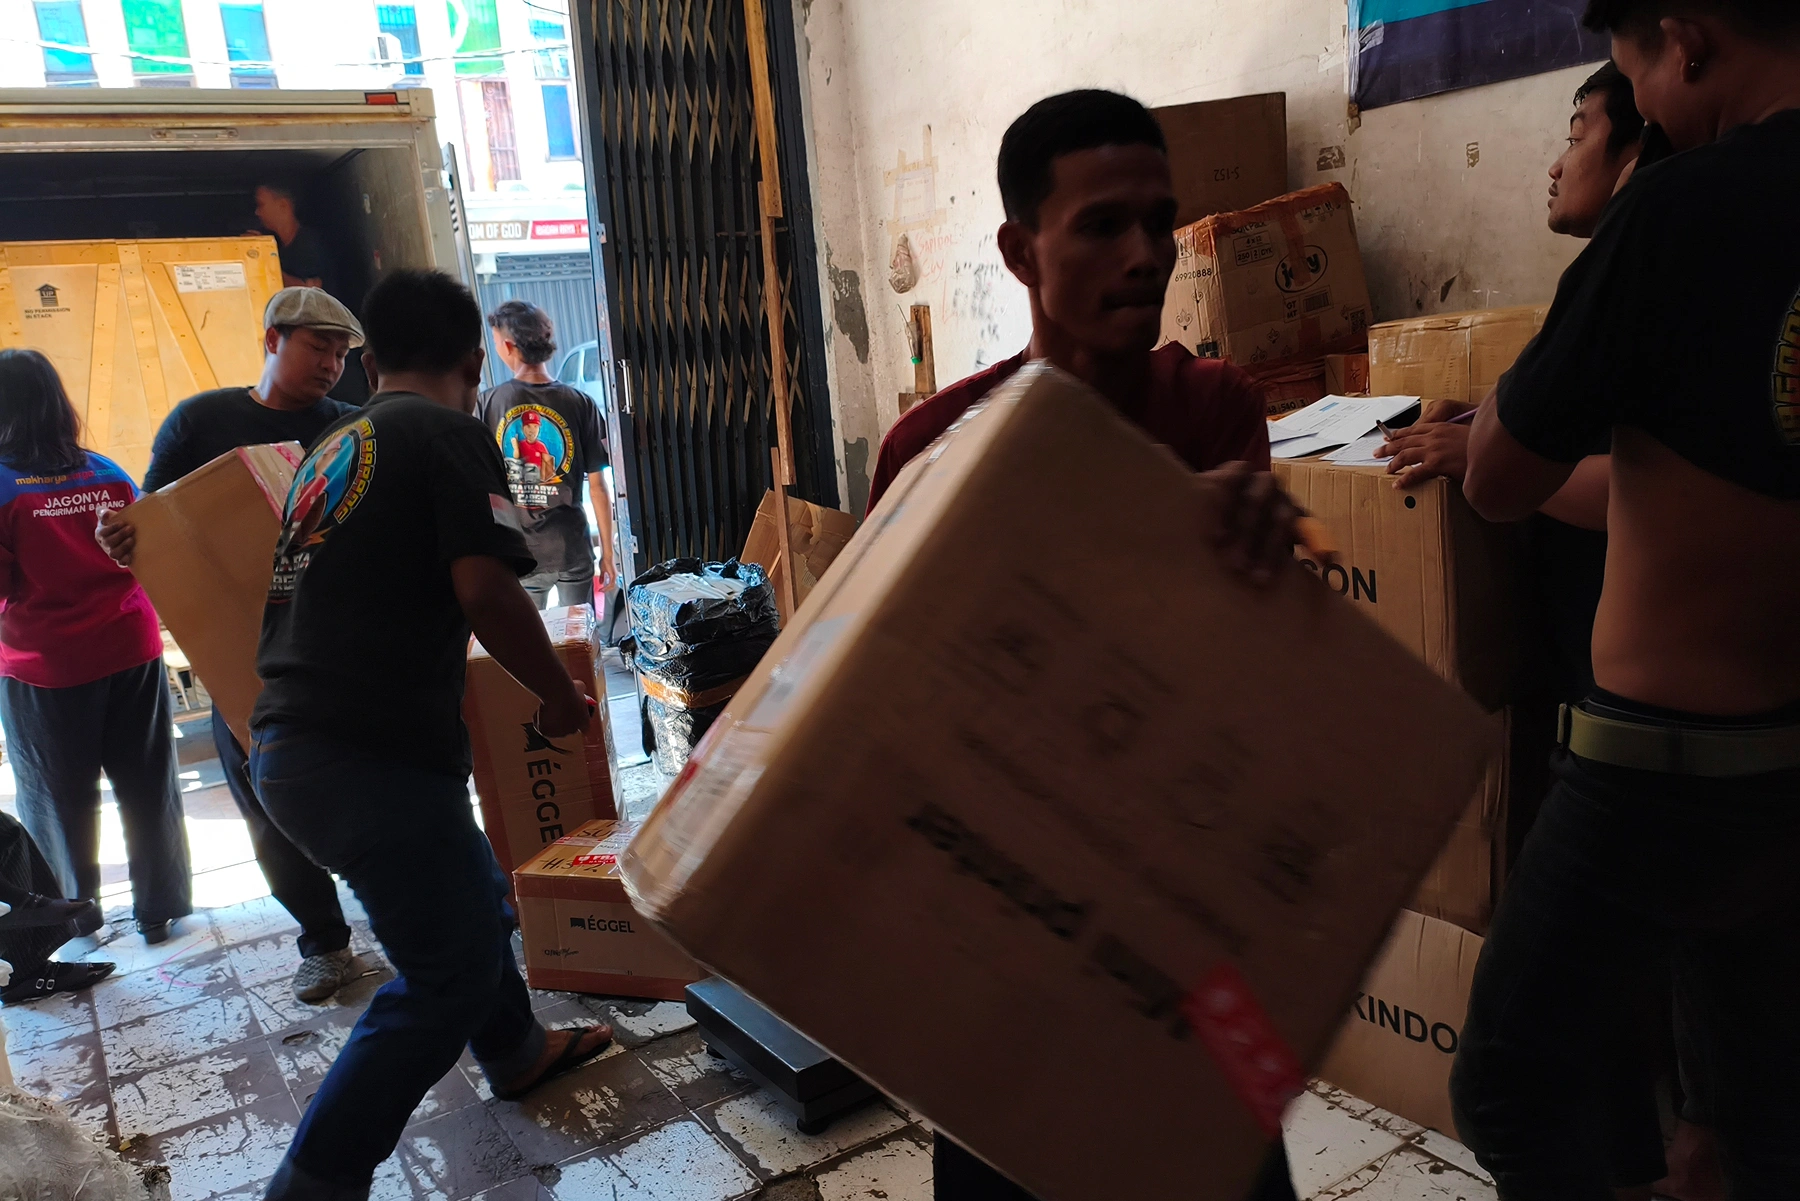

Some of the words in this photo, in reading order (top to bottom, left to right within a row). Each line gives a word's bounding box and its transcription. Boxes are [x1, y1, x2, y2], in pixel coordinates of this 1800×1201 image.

[1213, 166, 1240, 182] S-152
[486, 223, 499, 238] OF
[501, 222, 522, 238] GOD
[1237, 252, 1250, 261] 250
[1174, 267, 1213, 283] 69920888
[1286, 300, 1298, 310] GT
[44, 489, 111, 508] JAGONYA
[32, 505, 86, 518] PENGIRIMAN
[88, 500, 125, 511] BARANG
[526, 758, 564, 849] ÉGGE
[587, 914, 635, 933] ÉGGEL
